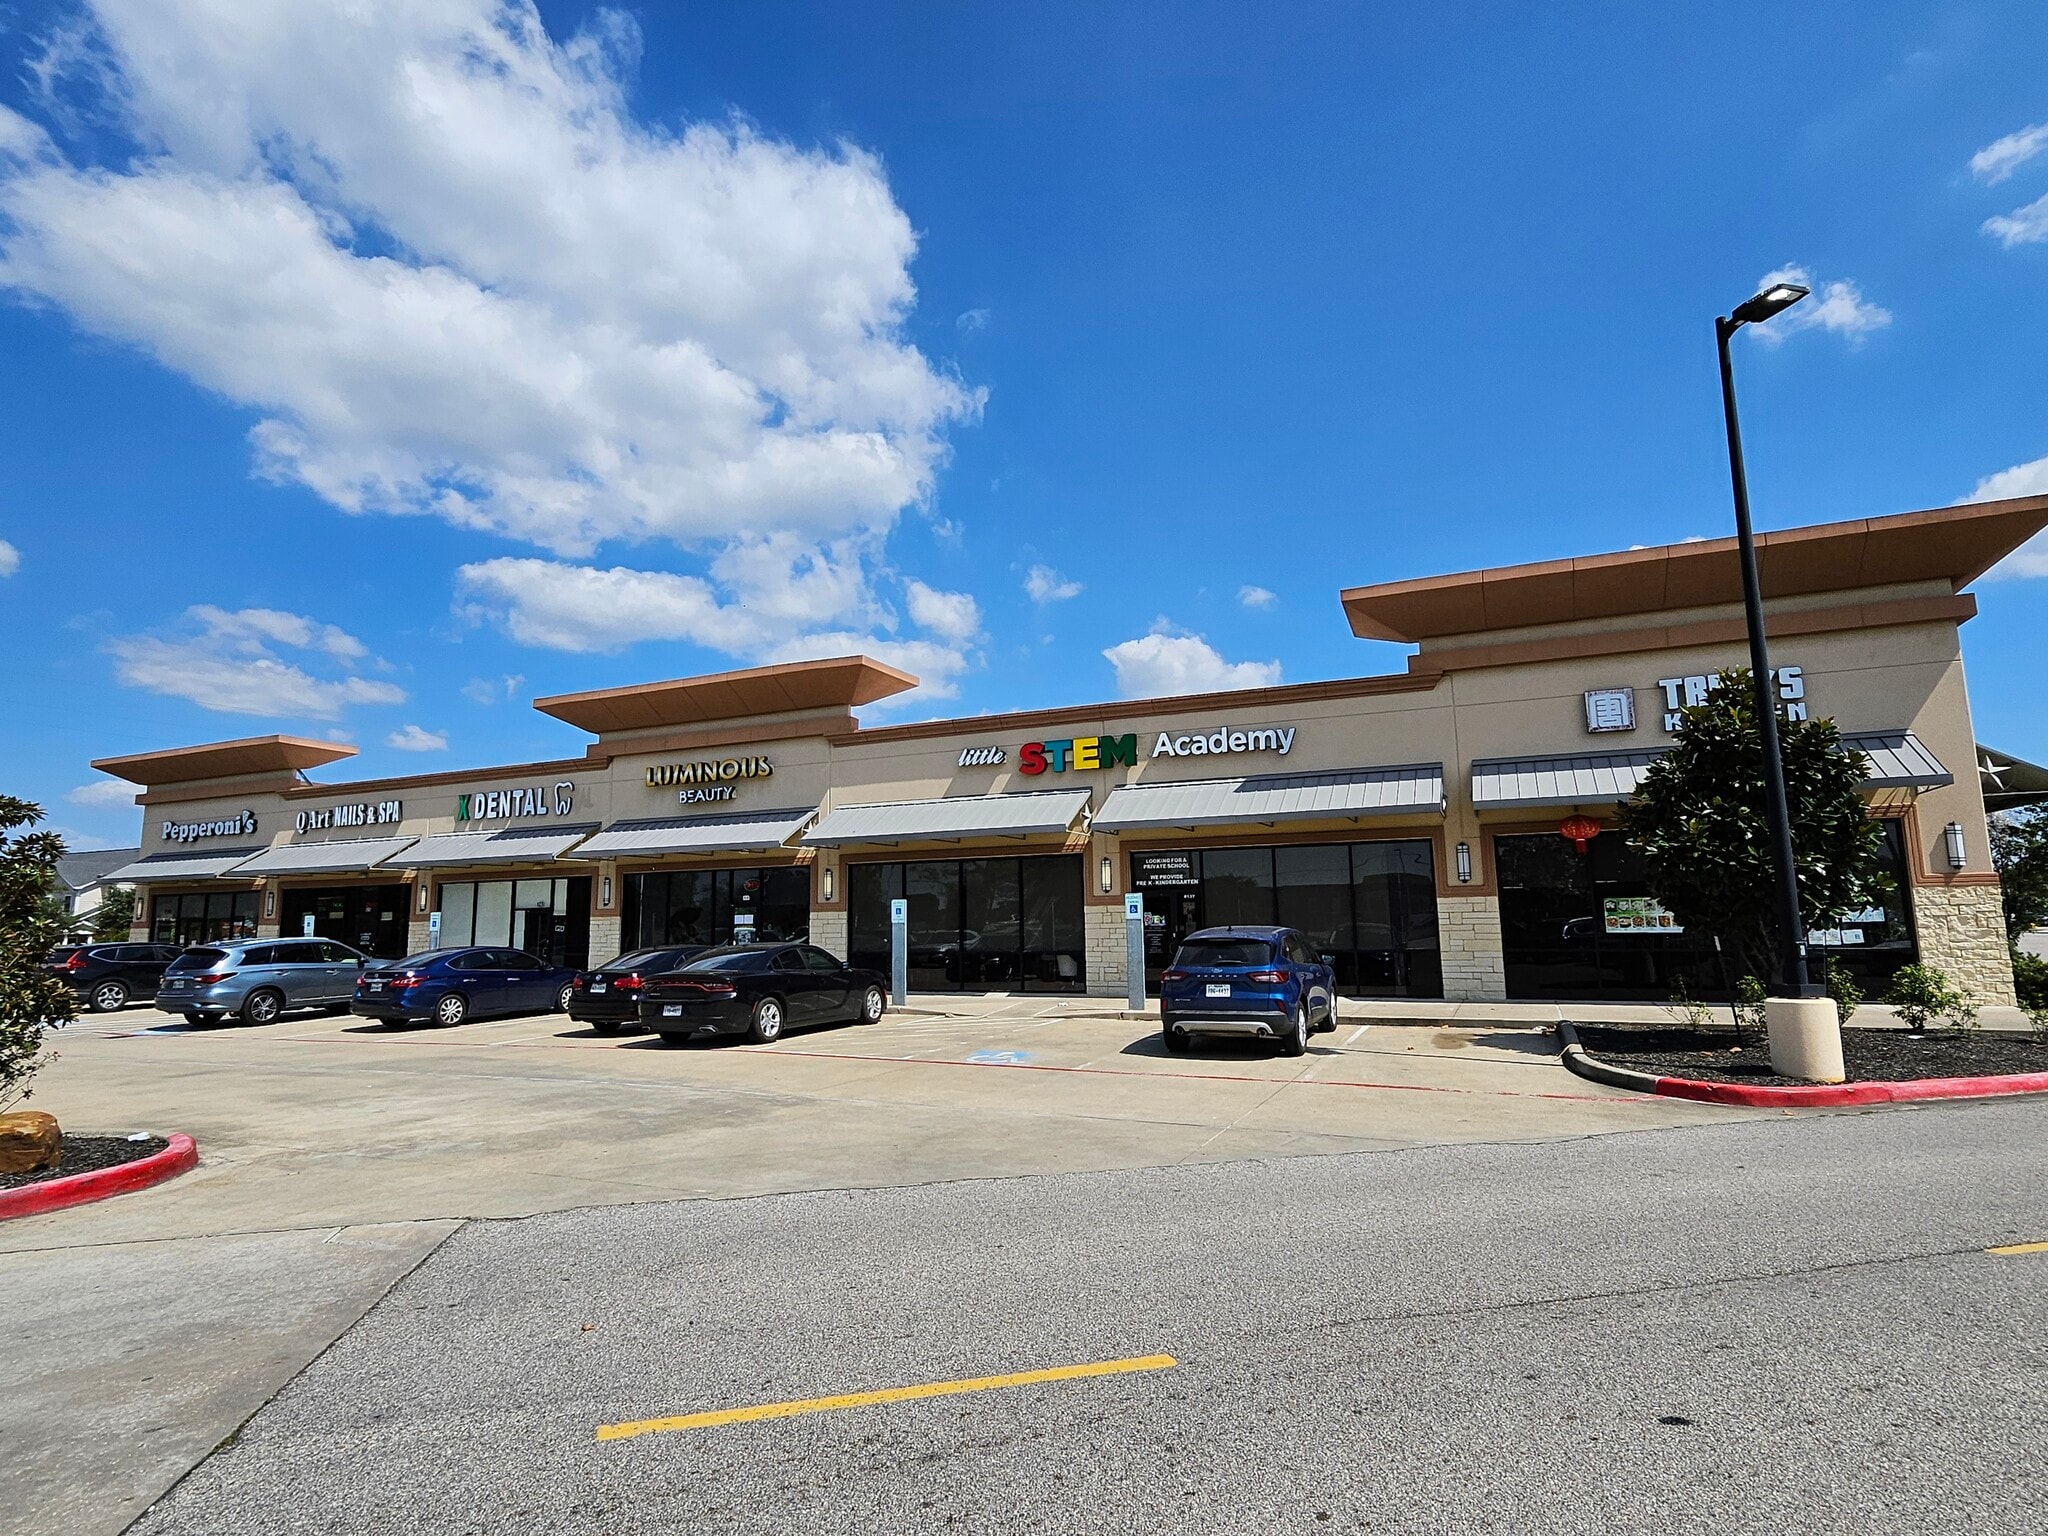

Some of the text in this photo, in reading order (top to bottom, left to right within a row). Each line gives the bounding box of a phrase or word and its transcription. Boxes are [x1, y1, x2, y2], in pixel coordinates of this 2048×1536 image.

[958, 726, 1296, 775] little STEM Academy
[646, 756, 774, 787] LUMINOUS
[474, 787, 548, 820] DENTAL
[679, 786, 735, 804] BEAUTY
[161, 810, 256, 842] Pepperoni's
[296, 801, 402, 834] Q Art NAILS & SPA
